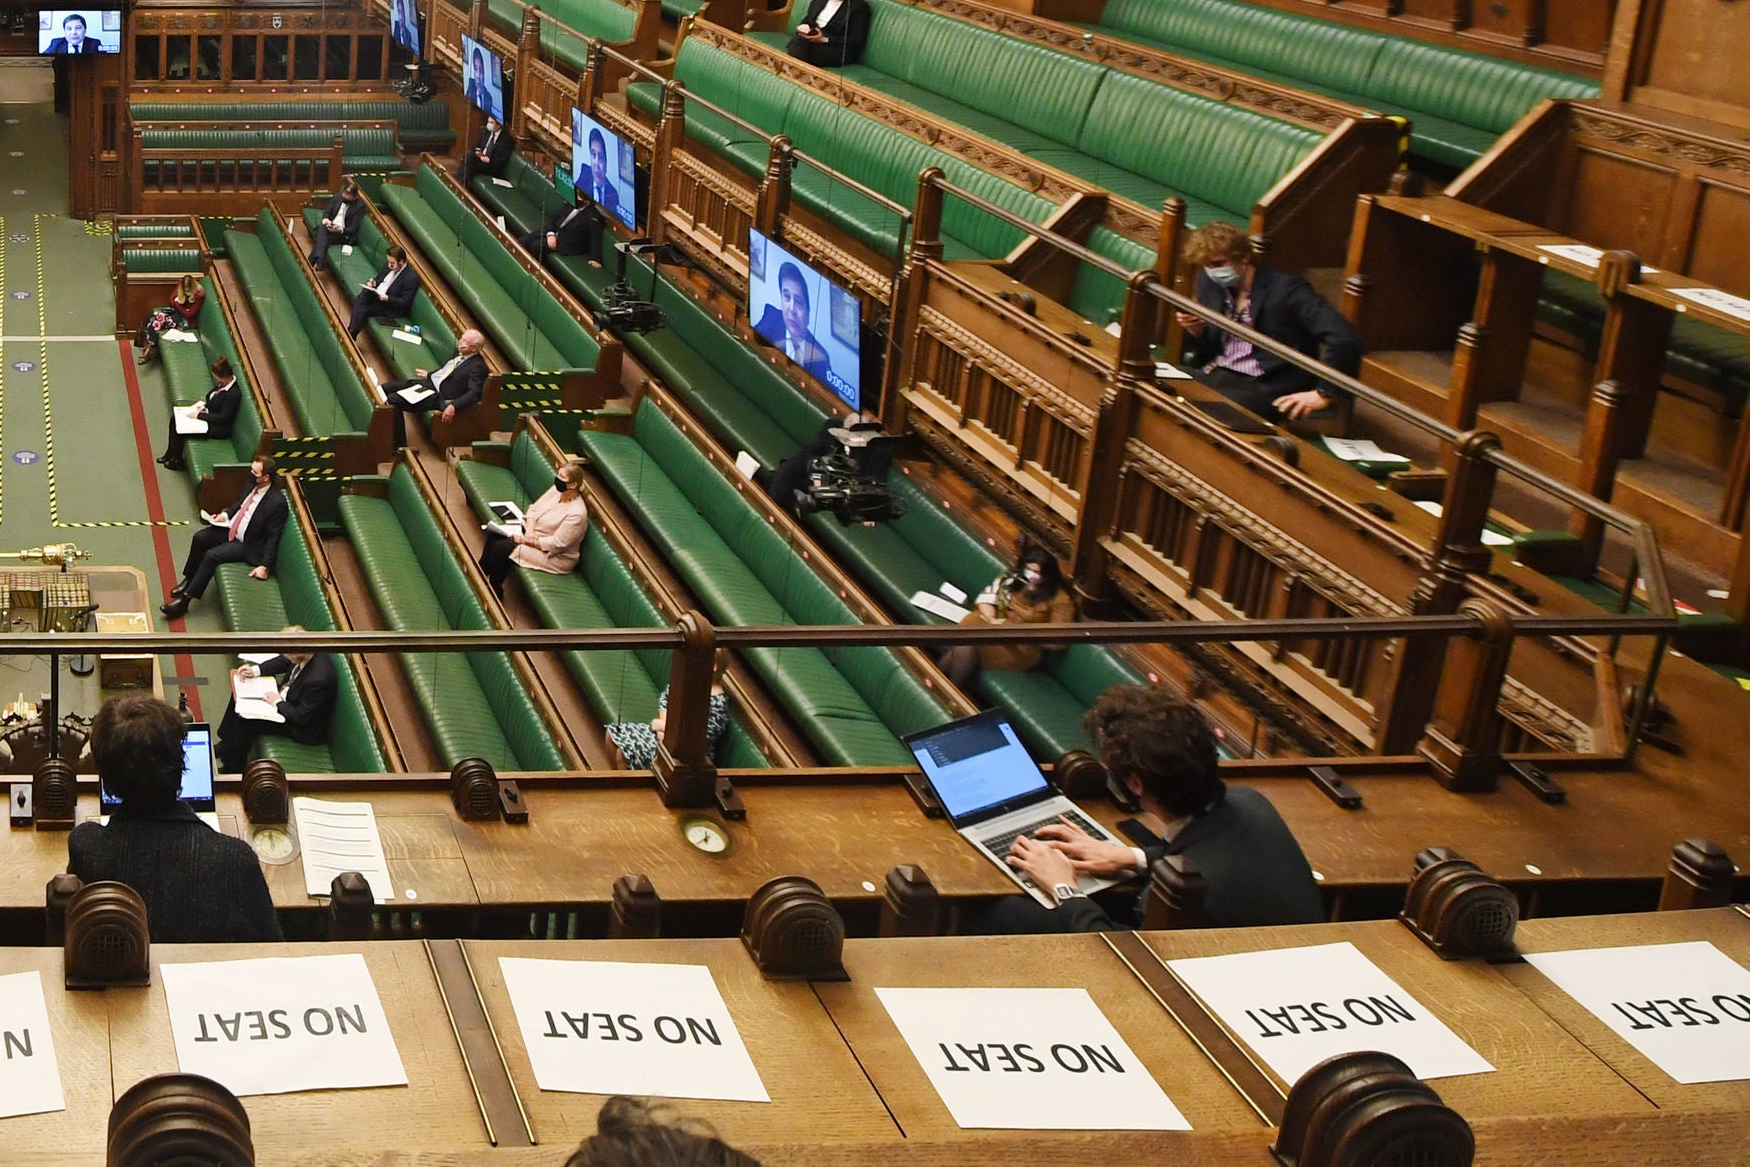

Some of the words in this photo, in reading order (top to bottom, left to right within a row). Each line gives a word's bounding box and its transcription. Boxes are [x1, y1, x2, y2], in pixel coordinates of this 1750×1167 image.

[826, 370, 855, 400] 0:00:00
[304, 1004, 367, 1037] NO
[1246, 1003, 1346, 1037] SEAT
[1344, 995, 1415, 1025] NO
[1612, 998, 1719, 1029] SEAT
[194, 1009, 290, 1042] SEAT
[544, 1011, 642, 1041] SEAT
[654, 1017, 721, 1045] NO
[944, 1044, 1045, 1072] SEAT
[1051, 1044, 1125, 1073] NO
